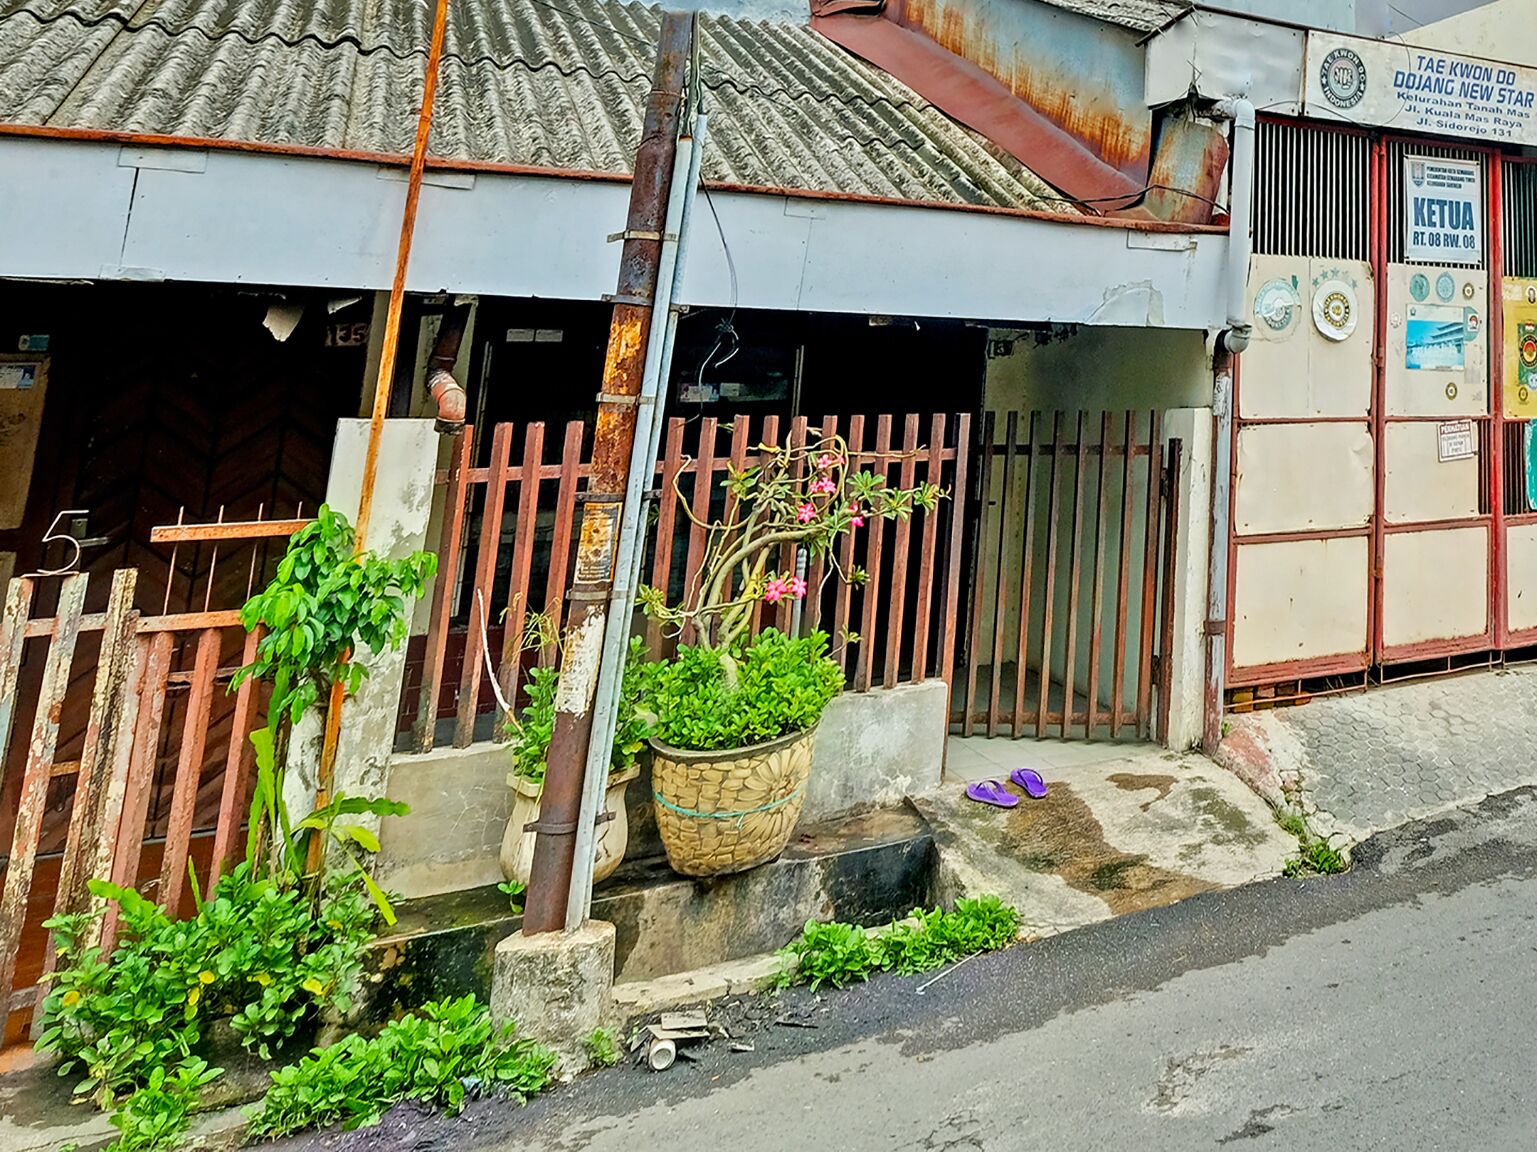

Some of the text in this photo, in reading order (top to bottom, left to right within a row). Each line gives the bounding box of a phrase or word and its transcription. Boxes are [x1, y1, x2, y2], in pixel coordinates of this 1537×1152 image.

[1417, 55, 1516, 86] TAE KWON DO
[1323, 86, 1364, 108] INDONESIA
[1393, 70, 1535, 108] DOJANG NEW STAR
[1397, 91, 1531, 119] Kelurahan Tanah Mas
[1405, 104, 1523, 130] Jl. Kuala Mas Raya
[1416, 117, 1512, 137] Jl. Sidorejo 131
[1413, 196, 1474, 230] KETUA
[1413, 231, 1475, 249] RT. 08 RW. 08
